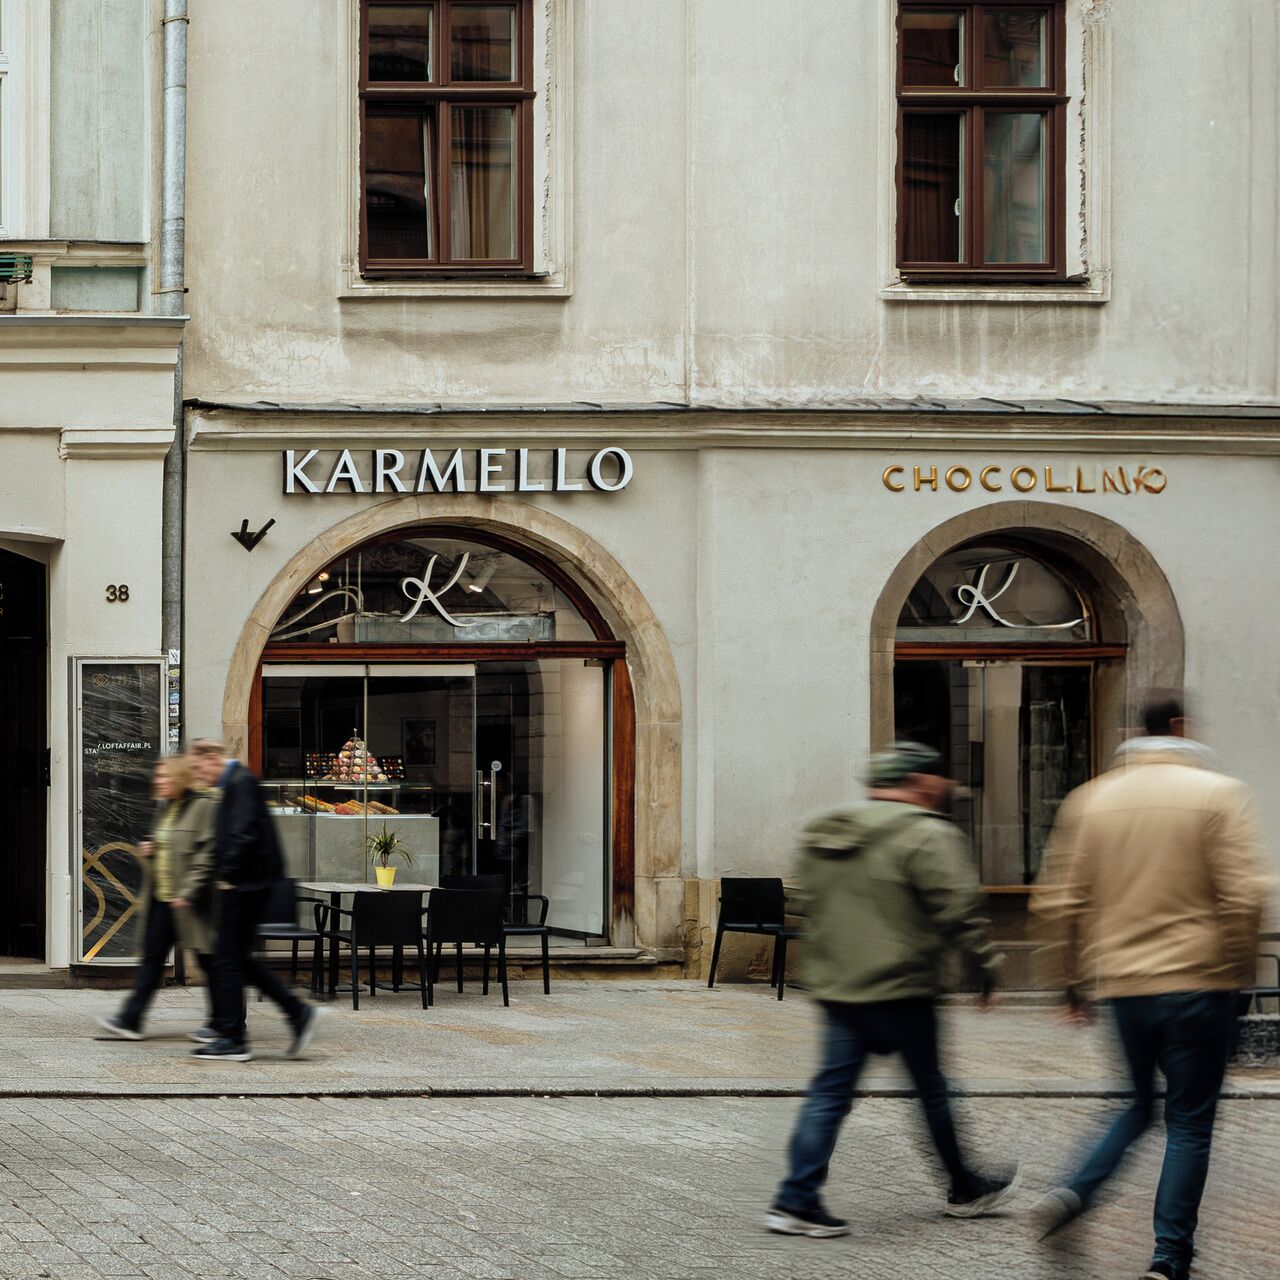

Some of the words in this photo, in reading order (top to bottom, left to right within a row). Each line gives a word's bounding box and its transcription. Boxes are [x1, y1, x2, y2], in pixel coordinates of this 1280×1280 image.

[283, 446, 634, 495] KARMELLO
[105, 584, 130, 603] 38
[398, 552, 477, 628] K
